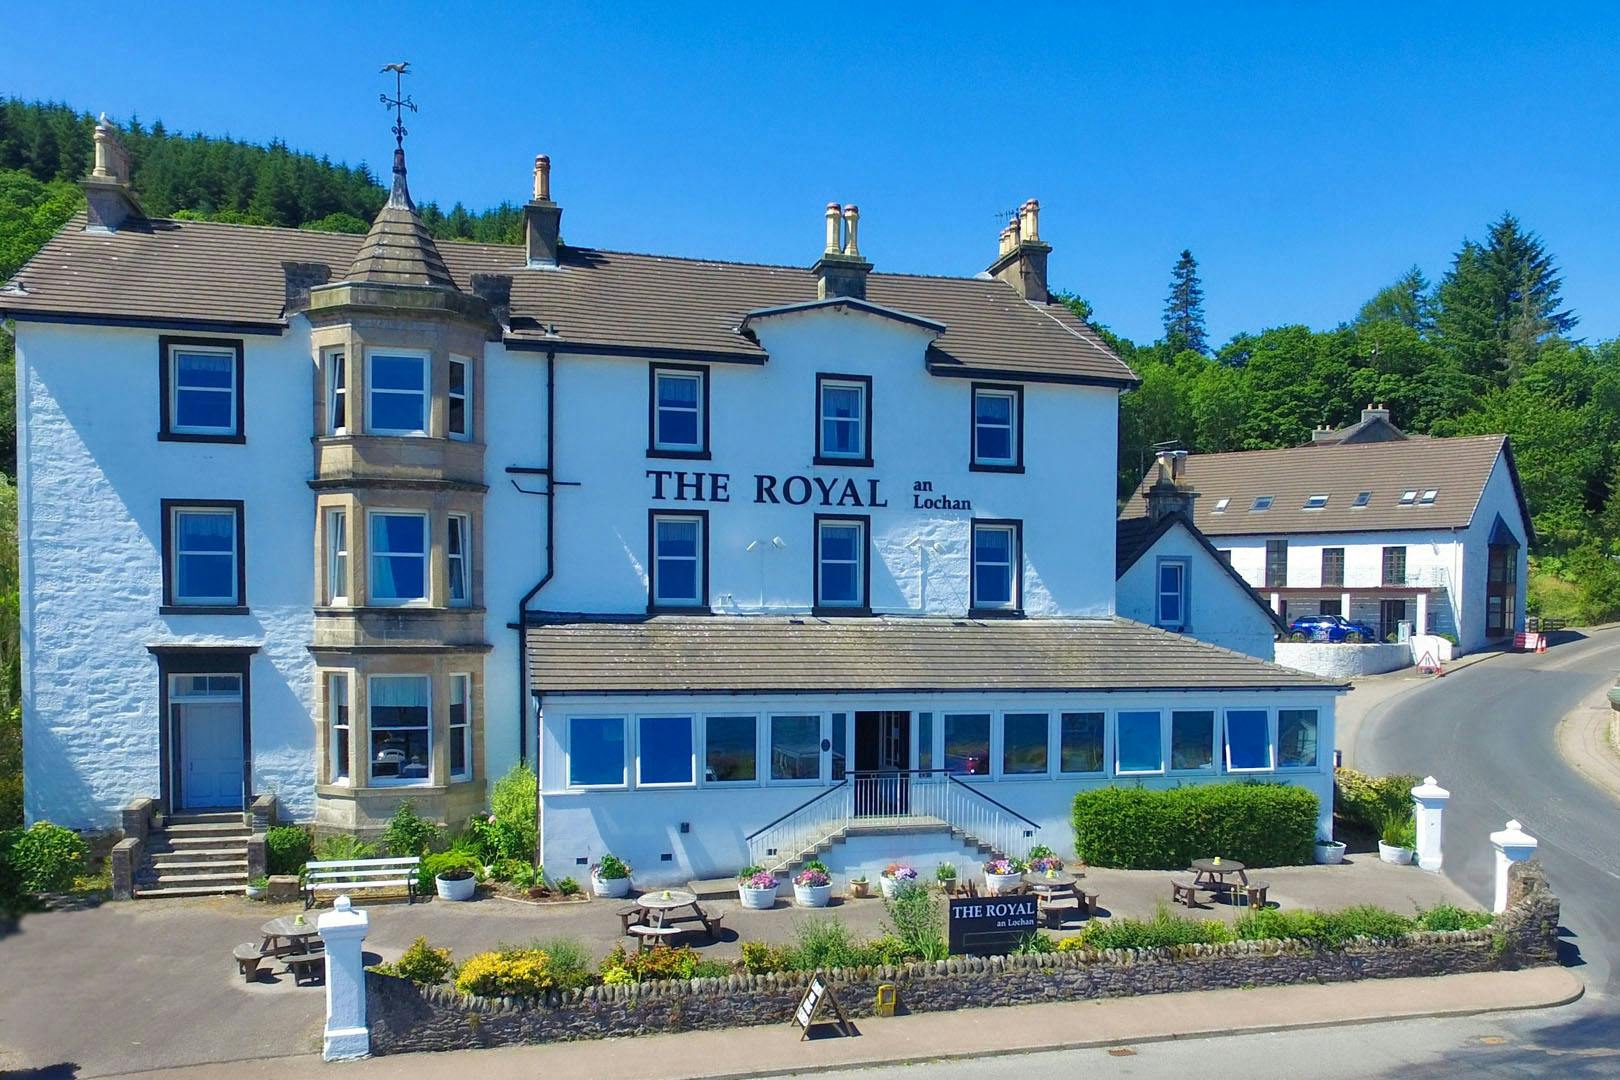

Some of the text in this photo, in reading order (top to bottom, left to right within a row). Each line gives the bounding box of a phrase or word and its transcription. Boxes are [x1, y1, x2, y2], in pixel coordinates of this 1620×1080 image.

[646, 470, 888, 507] THE ROYAL
[913, 479, 933, 492] an
[913, 494, 972, 510] Lochan
[952, 902, 1035, 919] THE ROYAL
[1007, 918, 1034, 927] Lochan
